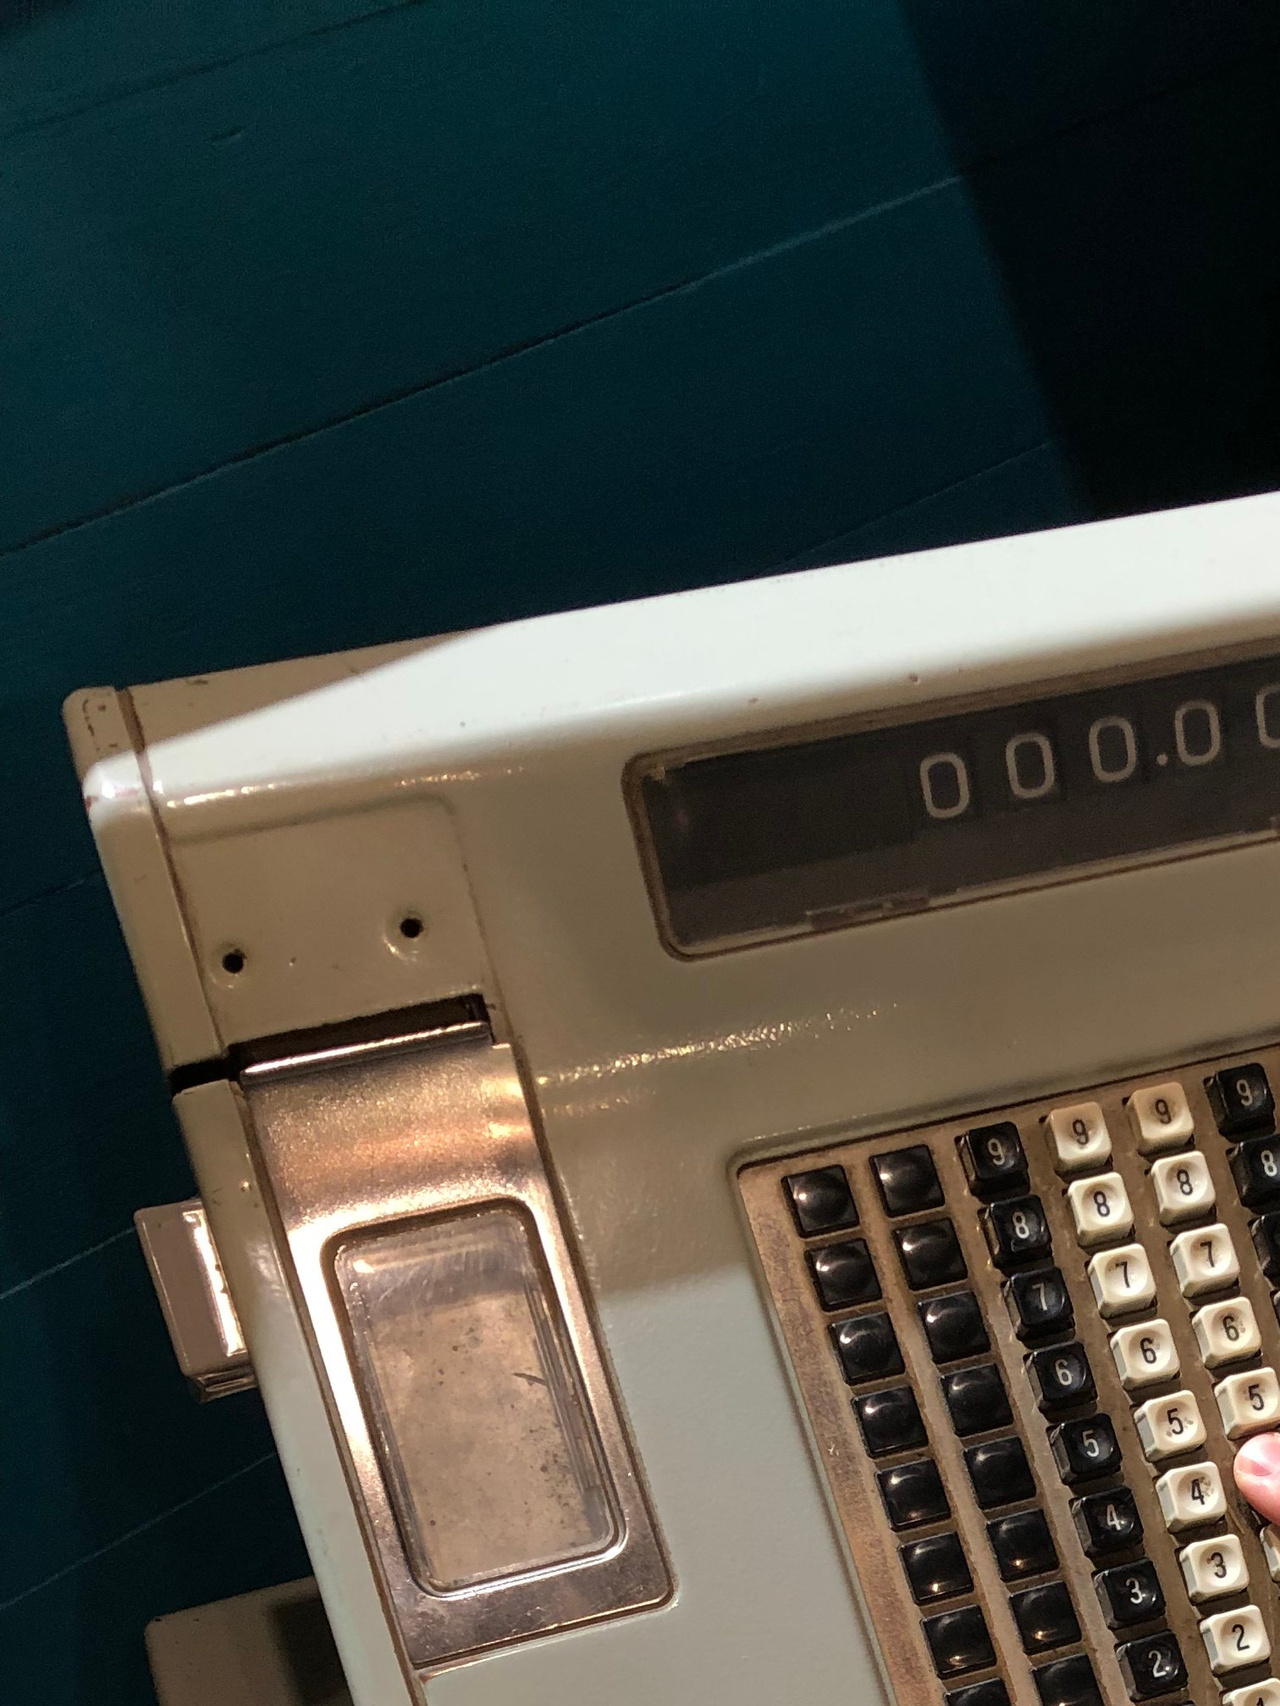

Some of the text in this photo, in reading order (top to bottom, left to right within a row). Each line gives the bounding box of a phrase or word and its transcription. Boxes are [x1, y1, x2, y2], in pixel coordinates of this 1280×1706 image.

[1236, 1079, 1253, 1106] 9
[1155, 1099, 1172, 1124] 9
[1072, 1119, 1089, 1145] 9
[988, 1138, 1004, 1166] 9
[1260, 1150, 1277, 1177] 8
[1176, 1169, 1193, 1196] 8
[1093, 1191, 1110, 1217] 8
[1012, 1211, 1030, 1239] 8
[1200, 1240, 1216, 1268] 7
[1115, 1261, 1131, 1288] 7
[1032, 1283, 1048, 1311] 7
[1222, 1315, 1240, 1342] 6
[1140, 1338, 1157, 1364] 6
[1054, 1359, 1072, 1386] 6
[1248, 1384, 1264, 1411] 5
[1167, 1408, 1183, 1435] 5
[1082, 1430, 1100, 1457] 5
[1191, 1479, 1206, 1505] 4
[1106, 1504, 1125, 1531] 4
[1210, 1552, 1227, 1579] 3
[1126, 1577, 1144, 1604] 3
[1232, 1624, 1250, 1651] 2
[1149, 1650, 1167, 1678] 2
